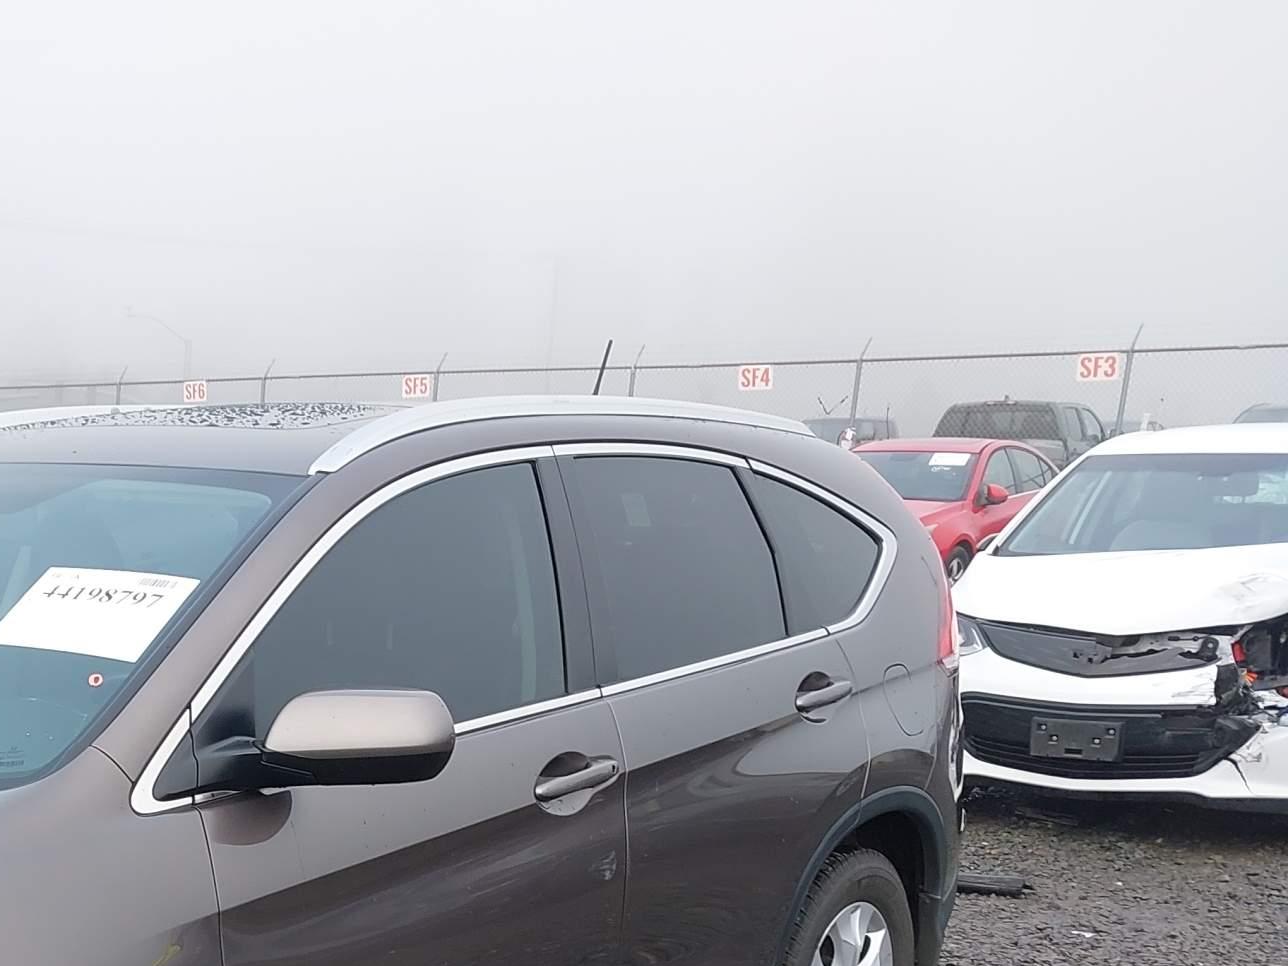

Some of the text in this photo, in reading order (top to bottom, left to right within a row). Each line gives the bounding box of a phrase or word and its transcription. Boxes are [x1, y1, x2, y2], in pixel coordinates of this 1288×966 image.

[741, 366, 771, 388] SF4
[1079, 355, 1117, 378] SF3
[184, 382, 206, 400] SF6
[404, 376, 428, 395] SF5
[42, 585, 165, 608] 44198797
